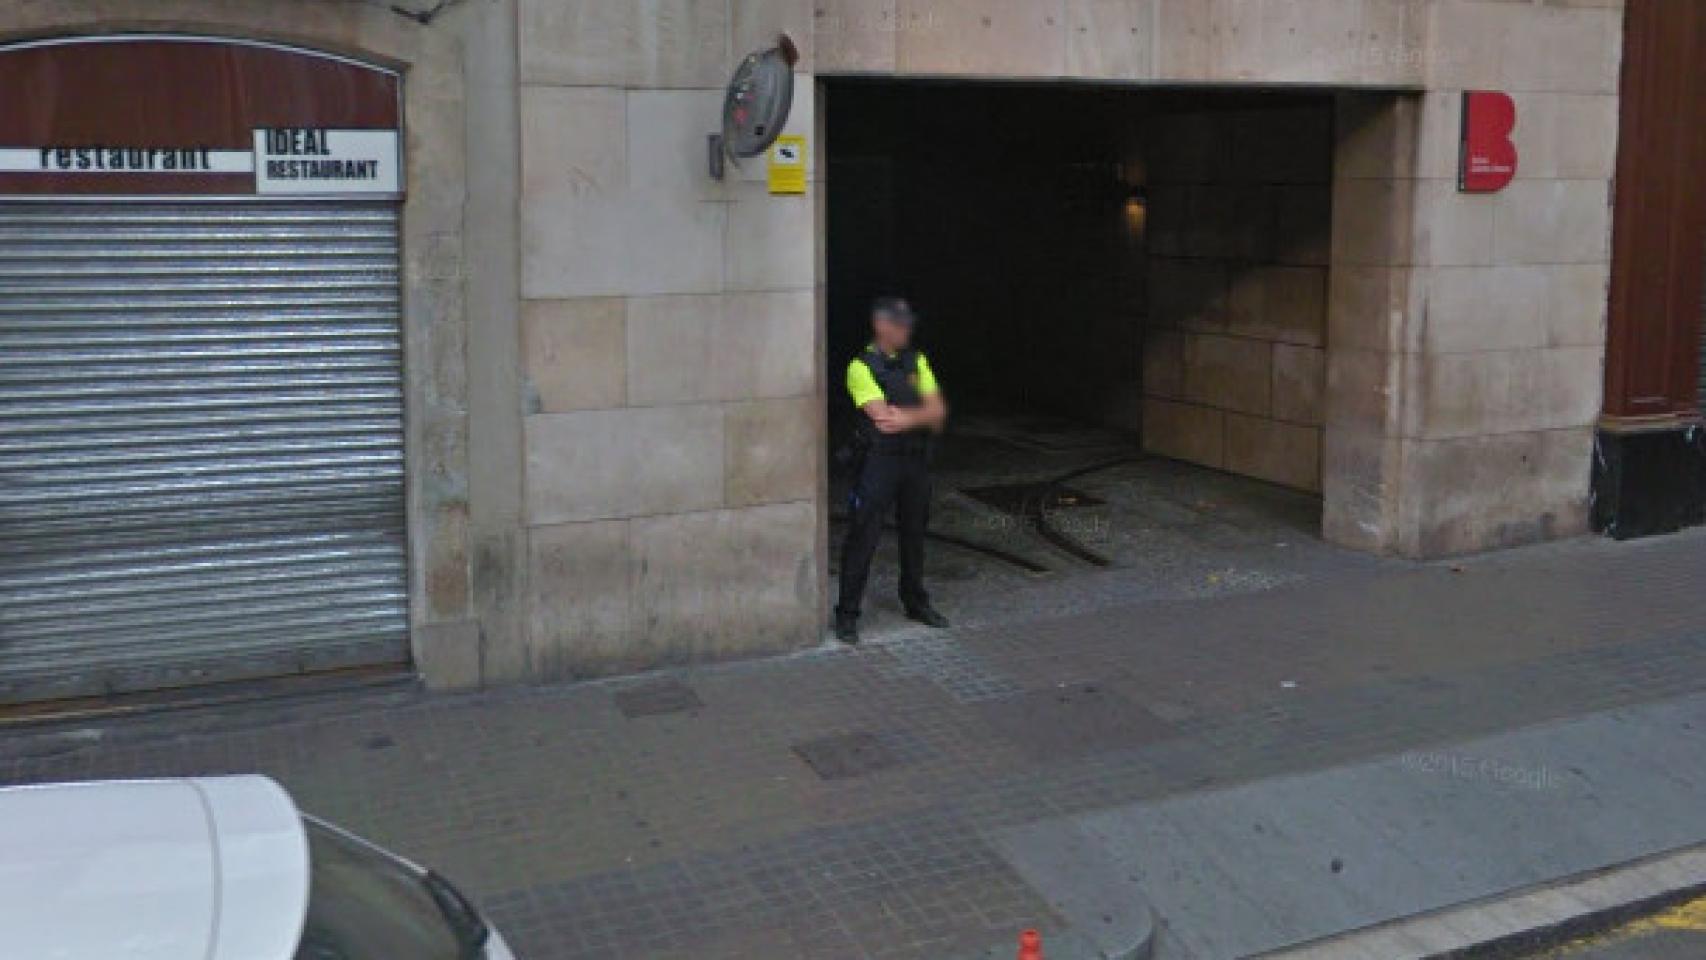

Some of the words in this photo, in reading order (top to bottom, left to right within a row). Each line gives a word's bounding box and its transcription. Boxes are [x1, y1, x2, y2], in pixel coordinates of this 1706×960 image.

[265, 129, 331, 155] IDEAL
[39, 148, 212, 170] restaurant
[266, 160, 379, 179] RESTAURANT
